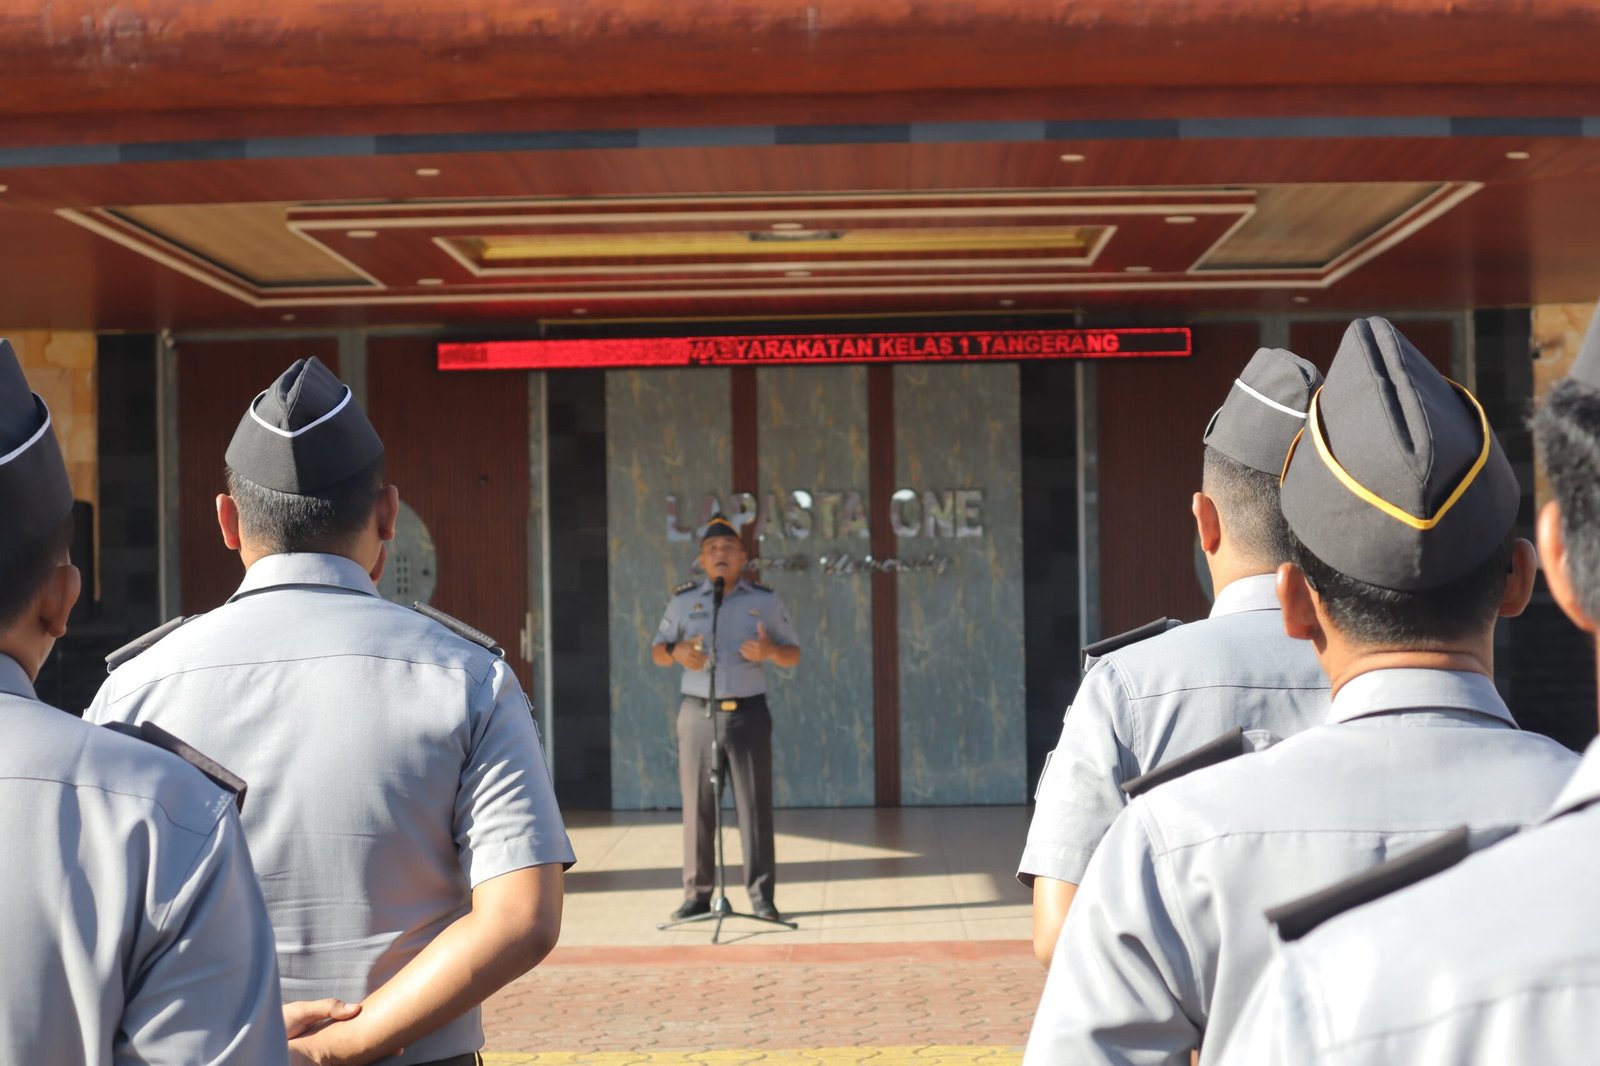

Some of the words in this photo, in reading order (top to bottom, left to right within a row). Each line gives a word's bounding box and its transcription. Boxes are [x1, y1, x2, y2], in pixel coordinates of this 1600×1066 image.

[879, 336, 953, 356] KELAS
[960, 335, 970, 355] 1
[977, 333, 1120, 354] TANGERANG
[890, 488, 984, 539] ONE
